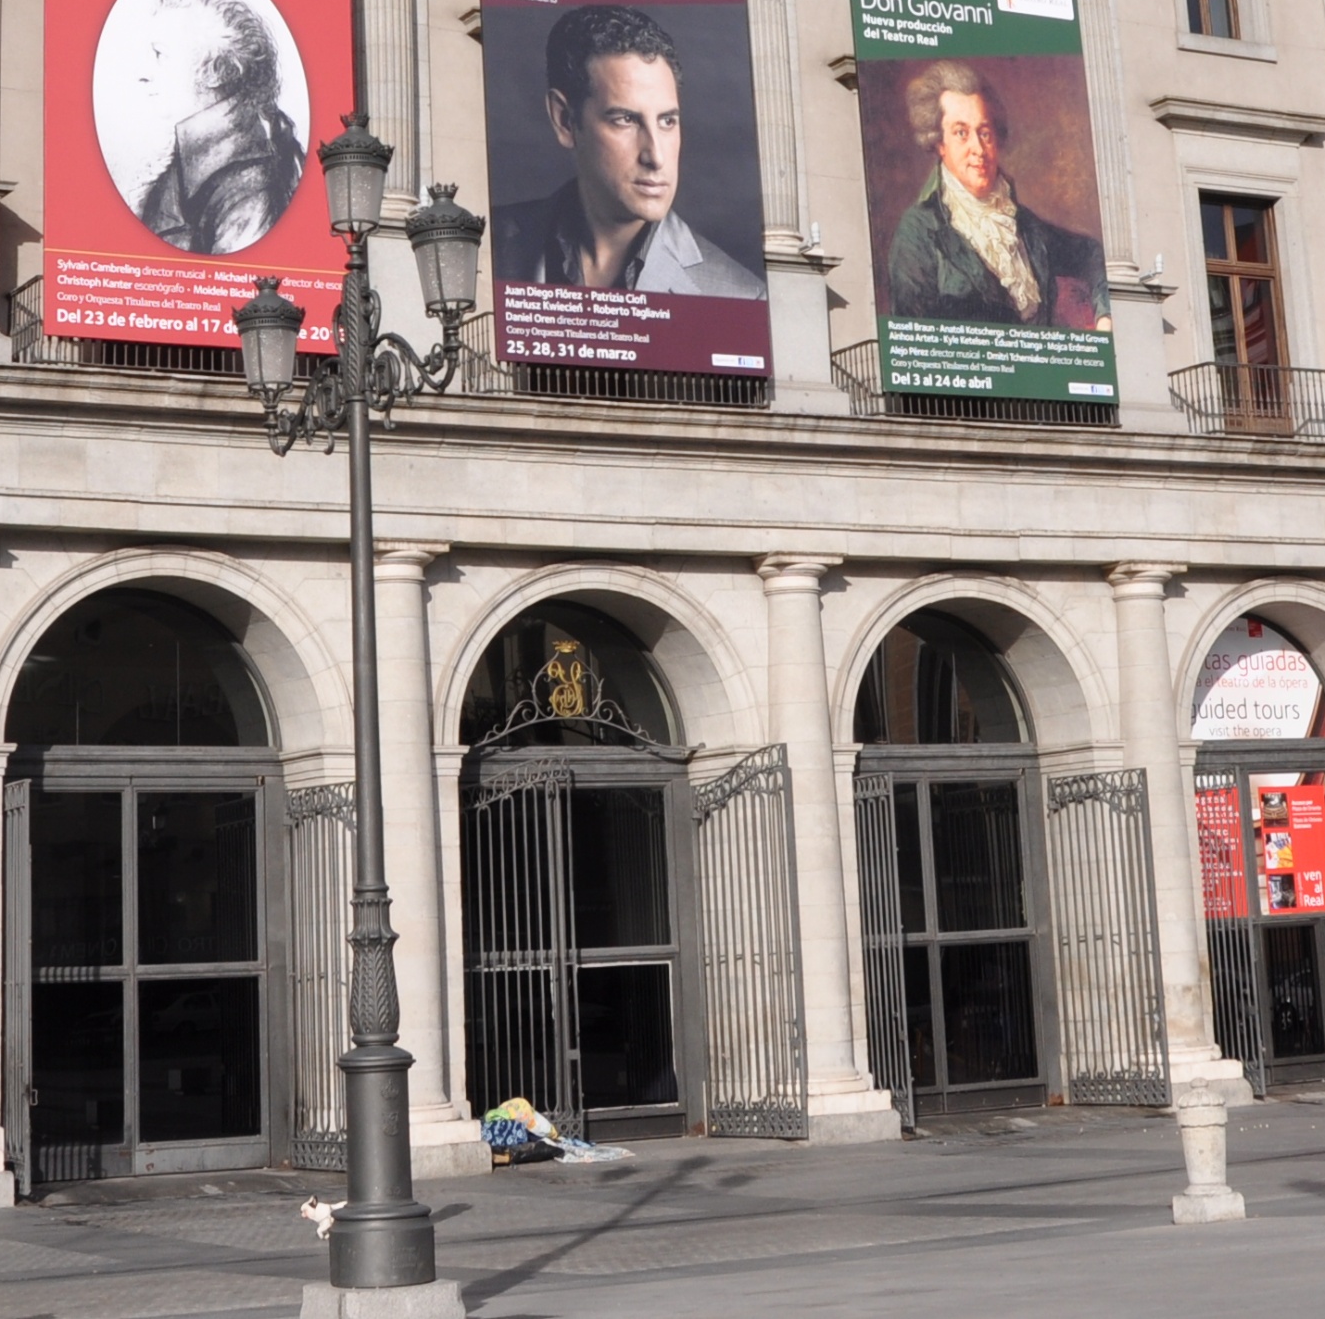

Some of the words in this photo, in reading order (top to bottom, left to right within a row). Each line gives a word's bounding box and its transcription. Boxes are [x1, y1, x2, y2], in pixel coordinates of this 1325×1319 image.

[862, 13, 894, 27] Nueva
[896, 17, 953, 35] producción
[864, 27, 880, 39] del
[881, 30, 915, 44] Teatro
[916, 33, 938, 46] Real
[57, 258, 89, 272] Sylvain
[90, 261, 141, 277] Cambreling
[142, 266, 174, 277] director
[176, 269, 206, 280] musical
[214, 271, 248, 283] Michael
[281, 277, 312, 289] director
[314, 278, 325, 289] de
[57, 275, 101, 288] Christoph
[102, 278, 132, 290] Kanter
[134, 282, 184, 295] escenógrafo
[193, 285, 228, 297] Moidele
[229, 287, 255, 299] Bickel
[505, 285, 525, 296] Juan
[527, 286, 554, 300] Diego
[555, 288, 582, 300] Flórez
[591, 291, 624, 303] Patrizia
[625, 293, 647, 305] Ciofi
[57, 292, 78, 301] Coro
[79, 294, 84, 304] y
[85, 293, 123, 306] Orquesta
[124, 296, 160, 308] Titulares
[161, 299, 174, 309] del
[175, 300, 201, 311] Teatro
[202, 302, 221, 312] Real
[505, 298, 541, 310] Mariusz
[593, 304, 630, 316] Roberto
[631, 307, 671, 320] Tagliavini
[57, 308, 81, 323] Del
[84, 310, 104, 325] 23
[107, 311, 126, 326] de
[129, 312, 183, 331] febrero
[185, 317, 198, 331] al
[201, 319, 220, 333] 17
[505, 312, 532, 322] Daniel
[534, 313, 555, 324] Oren
[556, 316, 587, 326] director
[589, 318, 619, 328] musical
[506, 325, 525, 335] Coro
[531, 327, 564, 338] Orquesta
[598, 330, 609, 340] del
[633, 334, 650, 343] Real
[888, 320, 913, 331] Russell
[1070, 333, 1085, 342] Paul
[507, 340, 530, 356] 25,
[532, 341, 555, 358] 28,
[558, 343, 574, 357] 31
[578, 344, 594, 358] de
[596, 347, 637, 361] marzo
[930, 349, 955, 358] director
[956, 350, 980, 359] musical
[1049, 355, 1073, 365] director
[1074, 357, 1082, 366] de
[891, 372, 910, 385] Del
[912, 373, 920, 386] 3
[922, 373, 933, 386] al
[935, 374, 951, 387] 24
[952, 375, 966, 388] de
[968, 376, 992, 389] abril
[1237, 648, 1307, 677] guiadas
[1217, 675, 1249, 688] teatro
[1252, 675, 1265, 688] de
[1267, 675, 1276, 688] la
[1279, 676, 1308, 691] ópera
[1191, 696, 1247, 727] guided
[1253, 700, 1300, 720] tours
[1209, 725, 1231, 737] visit
[1232, 725, 1246, 737] the
[1248, 727, 1282, 738] opera
[1303, 871, 1322, 881] ven
[1314, 882, 1323, 893] al
[1303, 894, 1325, 907] Real
